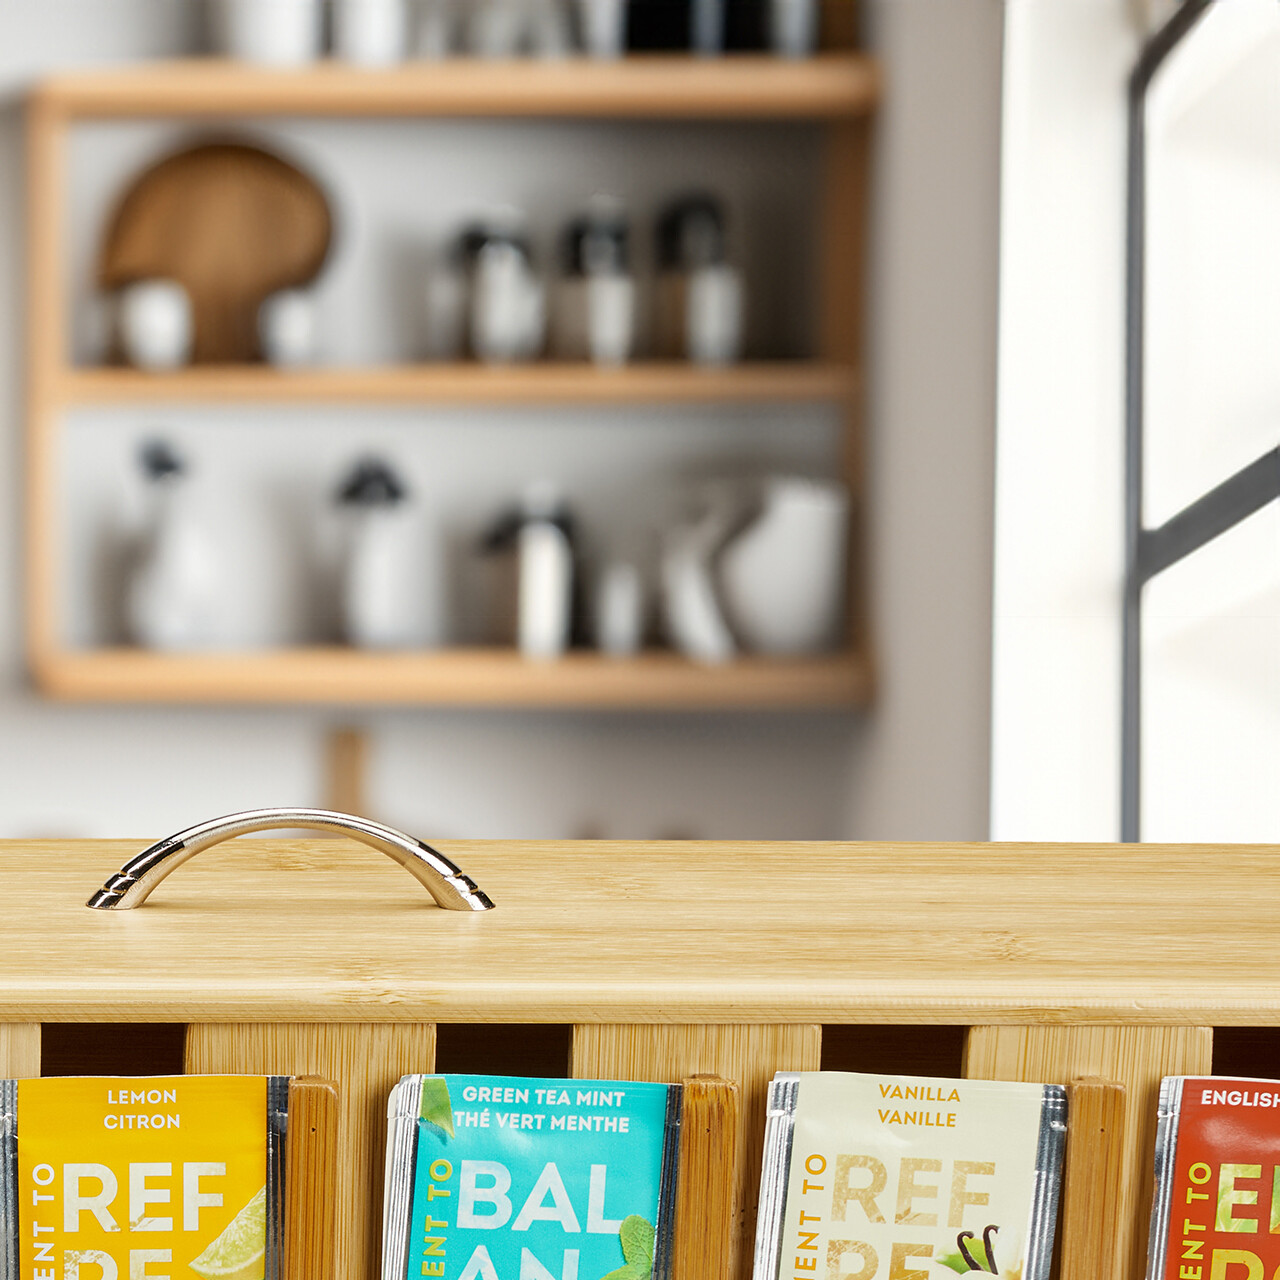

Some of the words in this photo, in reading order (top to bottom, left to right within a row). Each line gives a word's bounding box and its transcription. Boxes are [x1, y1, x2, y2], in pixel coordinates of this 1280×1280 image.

[108, 1089, 177, 1104] LEMON
[462, 1086, 531, 1104] GREEN
[535, 1089, 572, 1106] TEA
[575, 1091, 625, 1108] MINT
[879, 1084, 961, 1103] VANILLA
[104, 1114, 180, 1129] CITRON
[454, 1108, 490, 1128] THÉ
[495, 1113, 544, 1131] VERT
[551, 1115, 630, 1133] MENTHE
[877, 1109, 957, 1128] VANILLE
[32, 1163, 55, 1205] TO
[428, 1159, 453, 1202] TO
[802, 1154, 827, 1195] TO
[830, 1154, 996, 1228] REF
[1186, 1162, 1212, 1204] TO
[63, 1162, 226, 1233] REF
[456, 1159, 622, 1234] BAL
[1214, 1163, 1280, 1234] E
